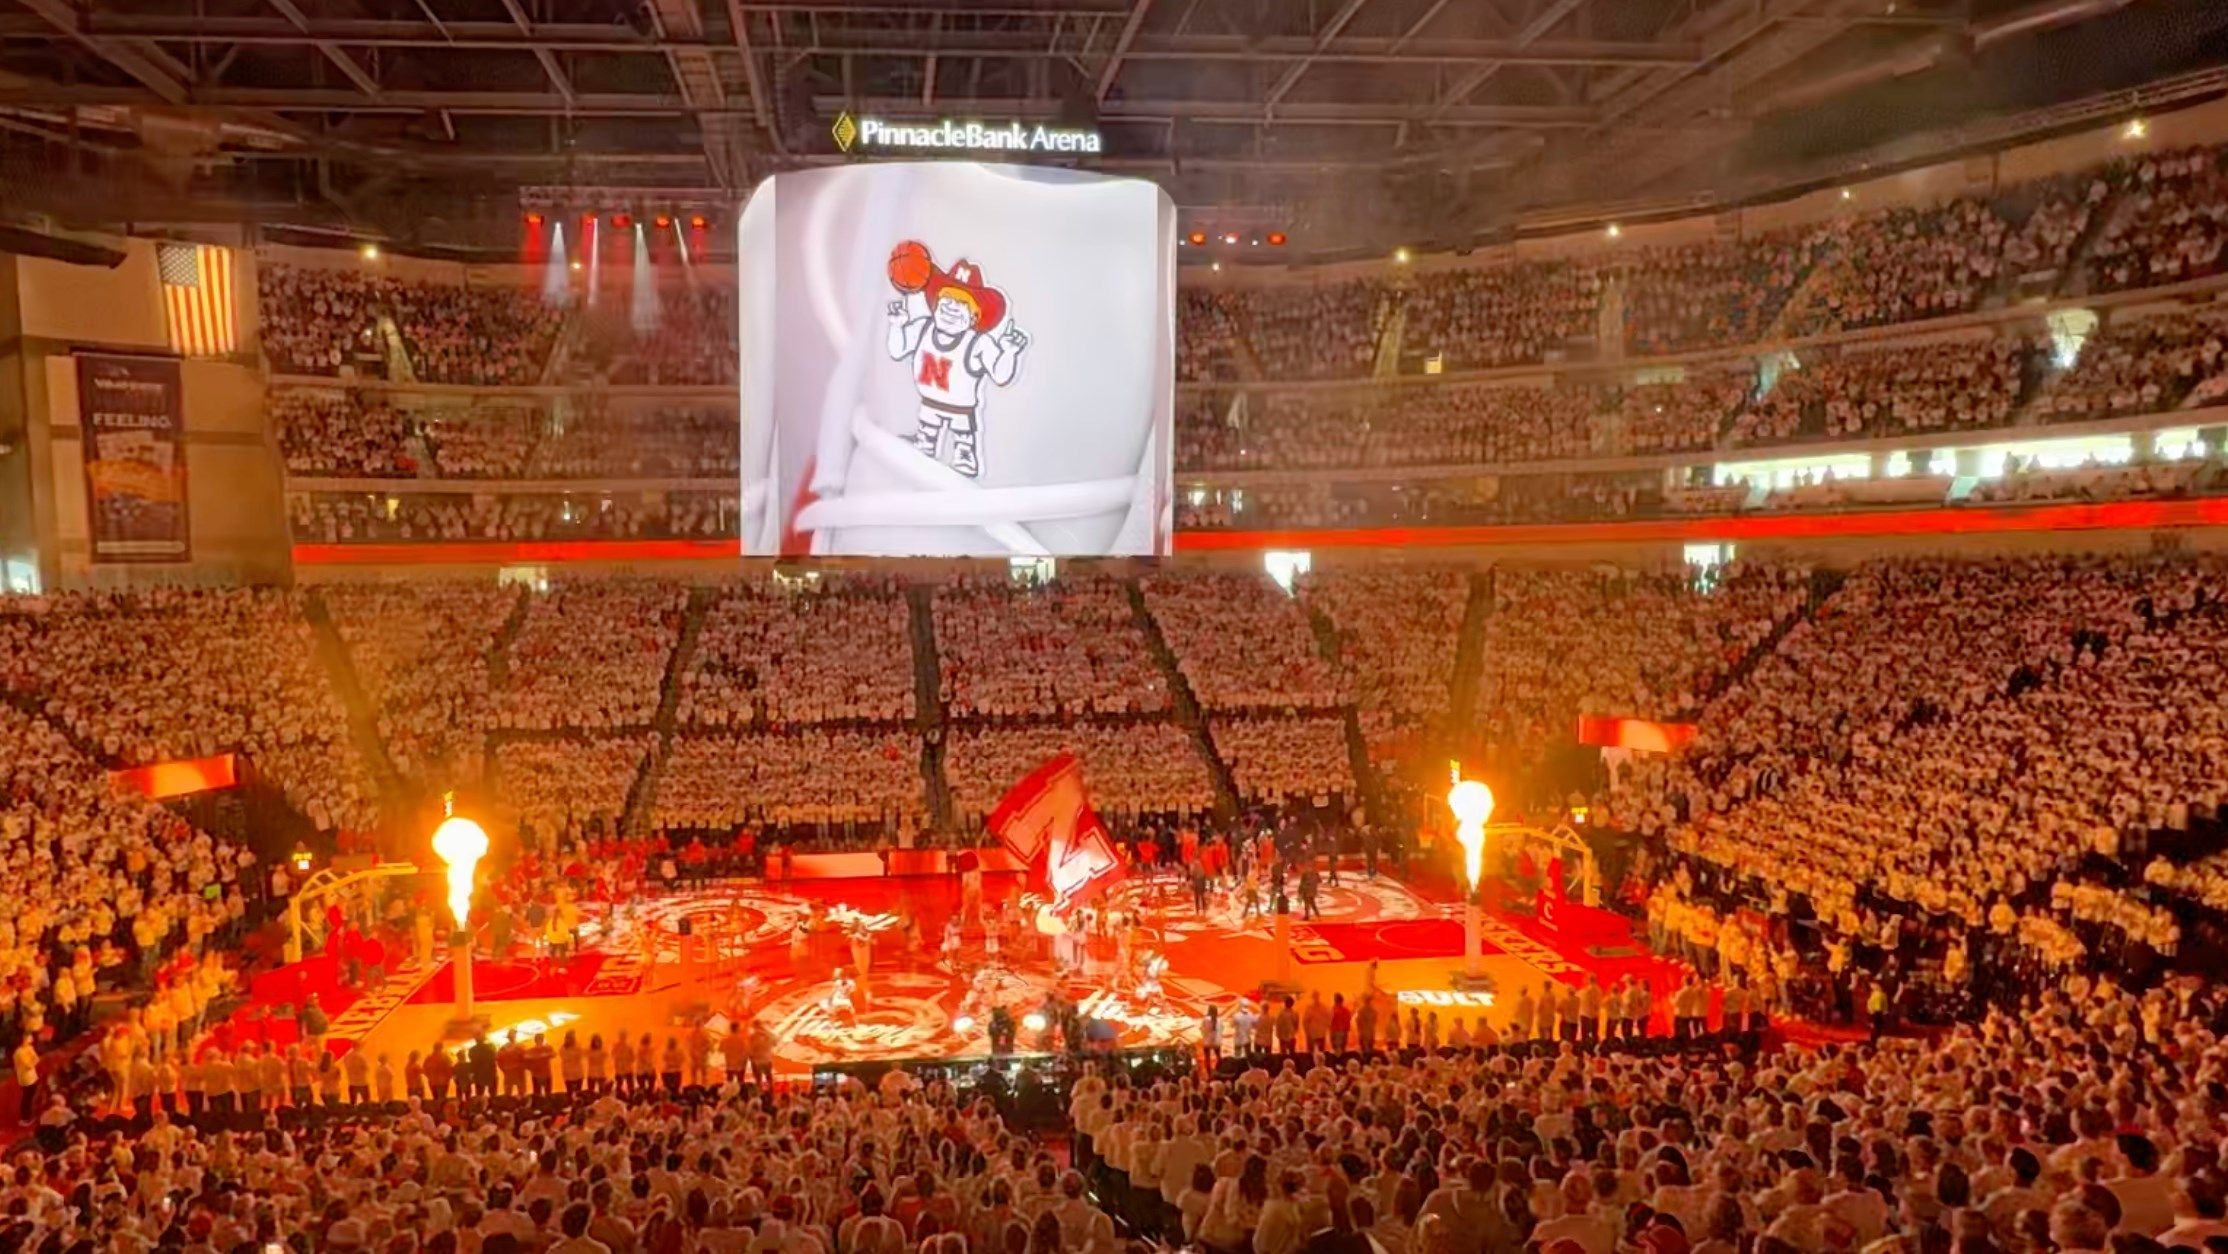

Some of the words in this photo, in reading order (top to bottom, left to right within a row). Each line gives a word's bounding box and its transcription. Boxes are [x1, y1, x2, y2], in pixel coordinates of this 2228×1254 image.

[1030, 126, 1100, 151] Arena
[955, 266, 972, 283] N
[918, 351, 952, 391] N
[999, 757, 1118, 900] N
